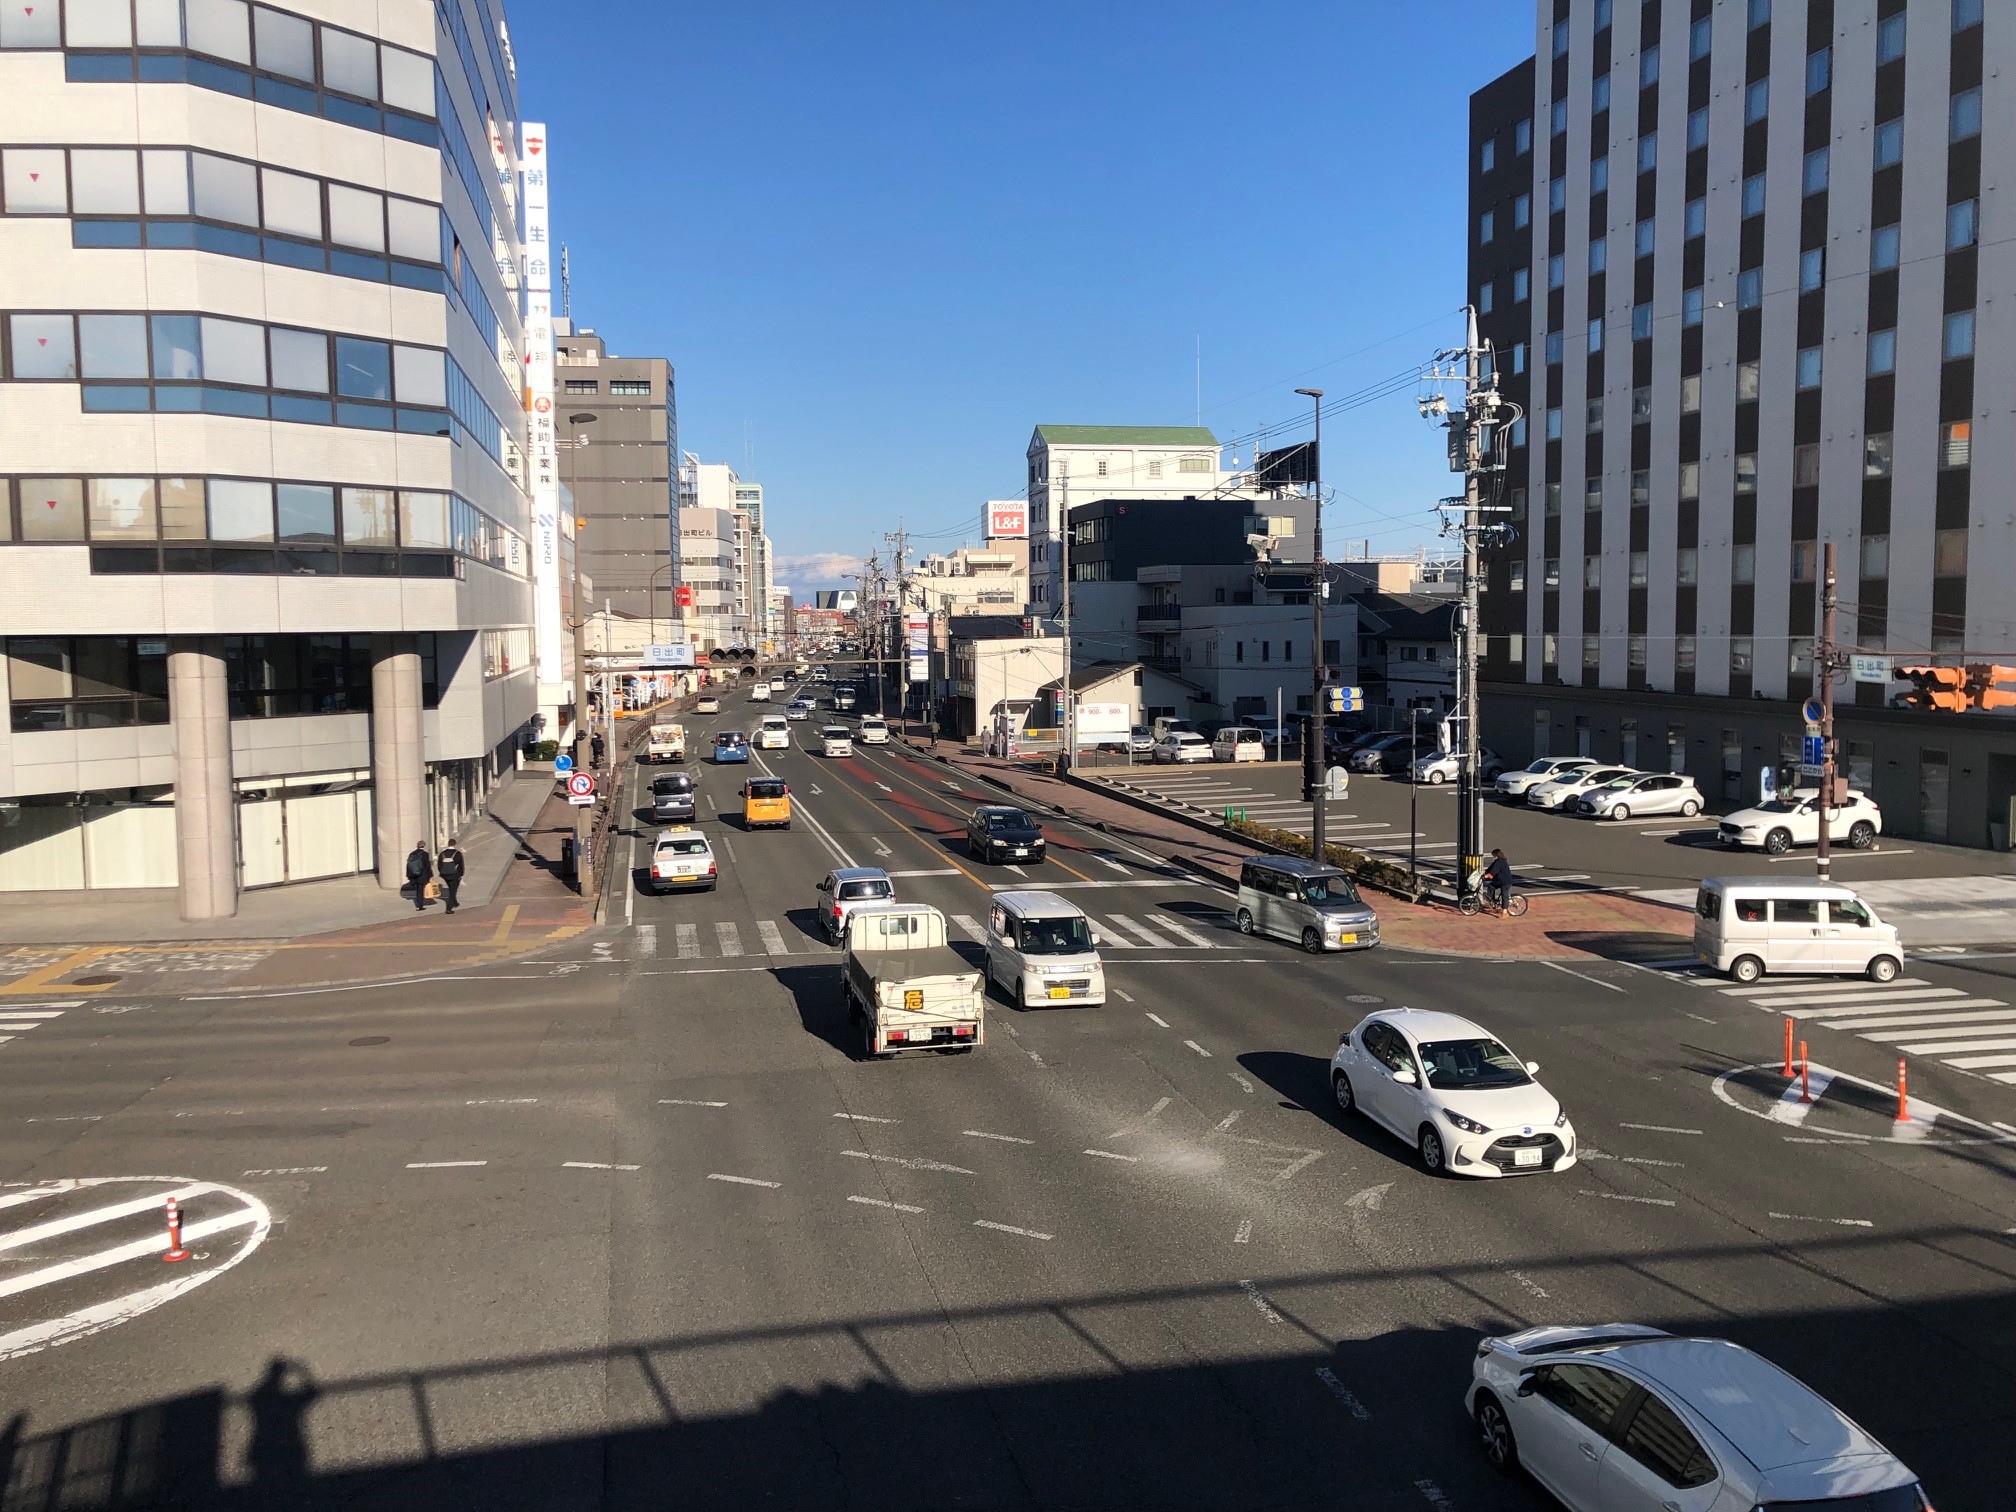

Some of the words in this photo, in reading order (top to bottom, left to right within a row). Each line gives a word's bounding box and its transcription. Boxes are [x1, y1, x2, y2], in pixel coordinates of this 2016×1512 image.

[528, 169, 546, 275] 第一生命
[995, 516, 1022, 529] L&F
[543, 531, 552, 564] NIPRO
[652, 647, 685, 656] 日出町
[1857, 659, 1884, 671] 日出町
[905, 990, 923, 1010] 危
